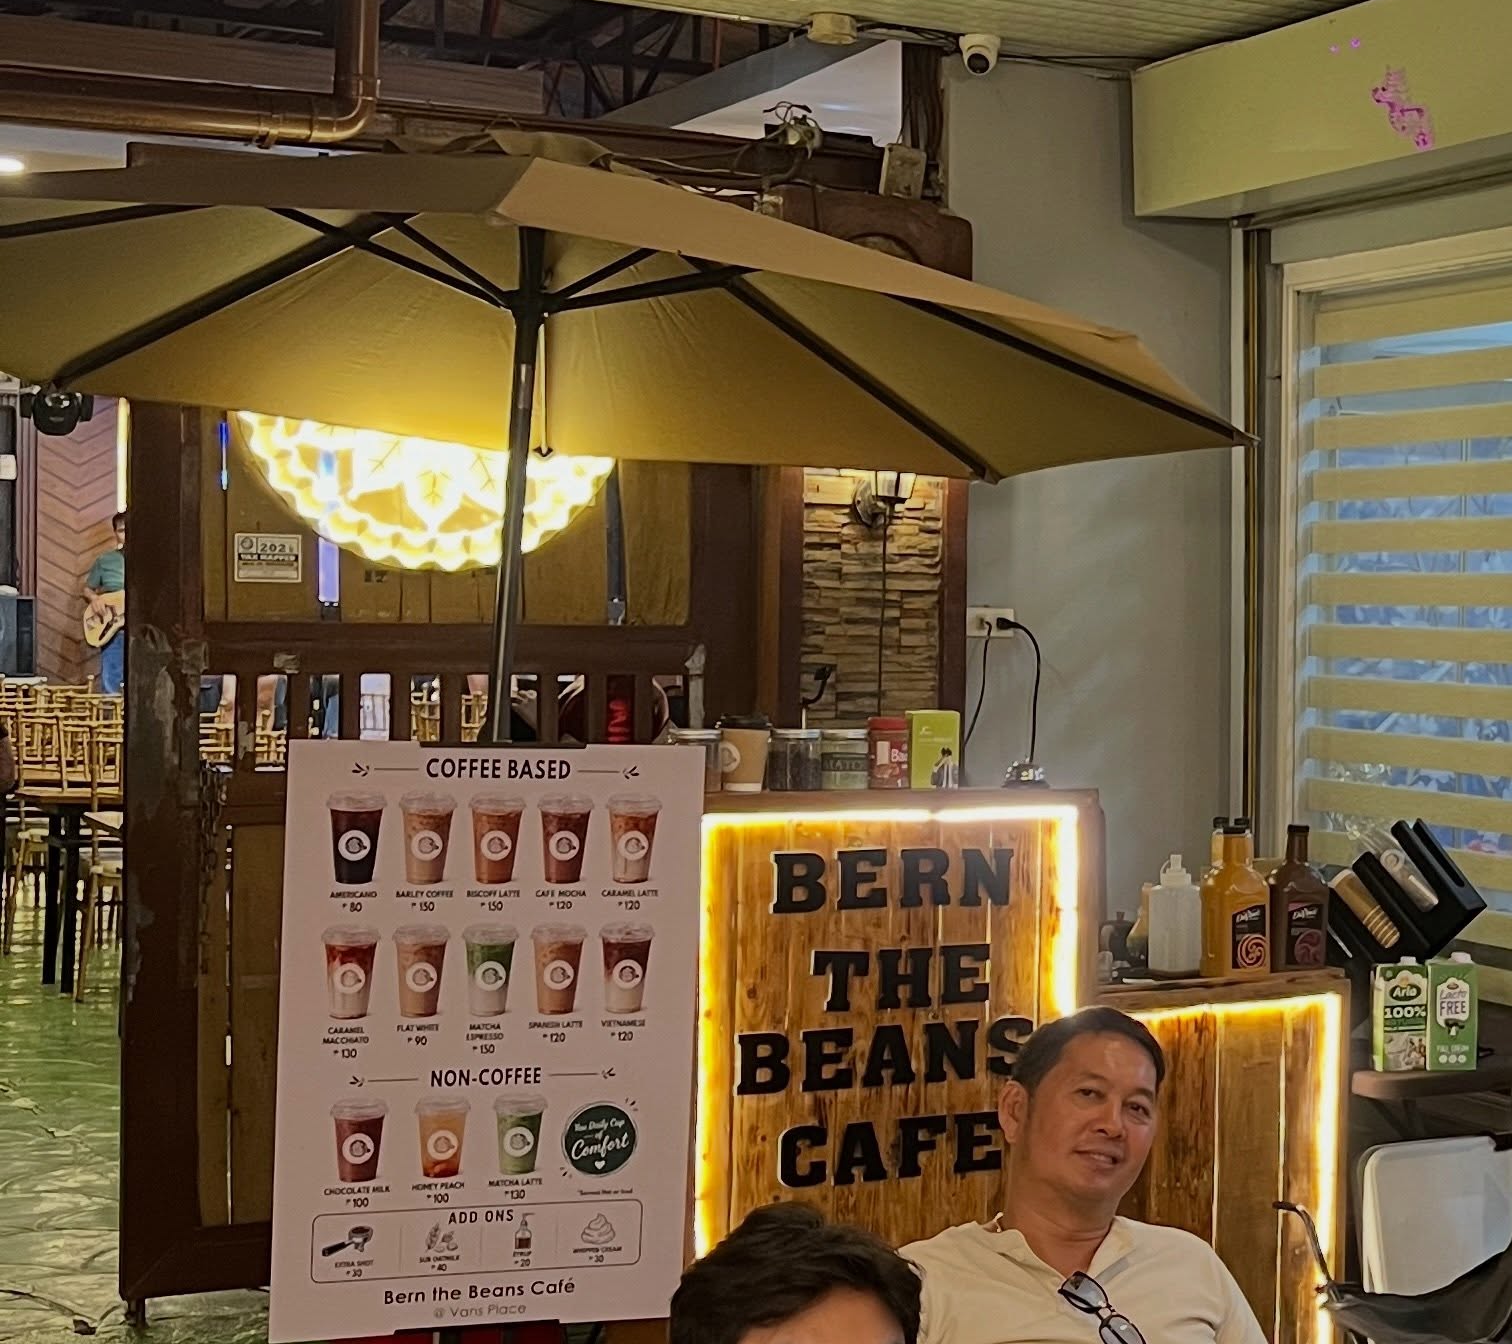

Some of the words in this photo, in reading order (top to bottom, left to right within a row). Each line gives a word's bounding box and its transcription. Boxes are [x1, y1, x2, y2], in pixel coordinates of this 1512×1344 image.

[426, 758, 501, 779] COFFEE
[507, 759, 572, 780] BASED
[770, 846, 1015, 915] BERN
[330, 890, 378, 899] AMERICANO
[396, 890, 425, 898] BARLEY
[426, 890, 454, 898] COFFEE
[466, 890, 498, 898] BISCOFF
[498, 890, 521, 898] LATTE
[558, 889, 587, 898] MOCHA
[601, 889, 636, 898] CARAMEL
[637, 889, 659, 897] LATTE
[349, 902, 363, 912] 80
[419, 901, 435, 912] 150
[487, 901, 504, 912] 150
[556, 900, 573, 910] 120
[624, 900, 641, 910] 120
[811, 942, 991, 1014] THE
[1384, 1006, 1427, 1018] 100%
[1440, 1000, 1467, 1016] FREE
[396, 1024, 415, 1032] FLAT
[416, 1023, 440, 1032] WHITE
[469, 1023, 501, 1031] MATCHA
[528, 1021, 560, 1029] SPANISH
[561, 1020, 583, 1028] LATTE
[600, 1018, 646, 1027] VIETNAMESE
[327, 1026, 365, 1035] CARAMEL
[617, 1031, 634, 1041] 120
[322, 1036, 369, 1045] MACCHIATO
[415, 1035, 428, 1046] 90
[466, 1032, 504, 1041] ESPRESSO
[550, 1032, 566, 1043] 120
[341, 1048, 358, 1059] 130
[480, 1044, 496, 1055] 150
[734, 1016, 1034, 1096] BEANS
[430, 1067, 542, 1088] NON-COFFEE
[571, 1131, 630, 1160] Comfort
[778, 1110, 1003, 1187] CAFE
[411, 1183, 438, 1191] HONEY
[440, 1181, 465, 1190] PEACH
[488, 1178, 520, 1187] MATCHA
[521, 1177, 543, 1186] LATTE
[323, 1186, 371, 1196] CHOCOLATE
[372, 1185, 391, 1194] MILK
[510, 1189, 526, 1200] 130
[352, 1197, 369, 1208] 100
[433, 1193, 449, 1204] 100
[448, 1210, 479, 1225] ADD
[484, 1209, 514, 1223] ONS
[384, 1289, 426, 1305] Bern
[432, 1286, 462, 1302] the
[468, 1284, 525, 1299] Beans
[530, 1277, 576, 1296] Café
[450, 1304, 484, 1317] Vans
[487, 1303, 527, 1316] Place
